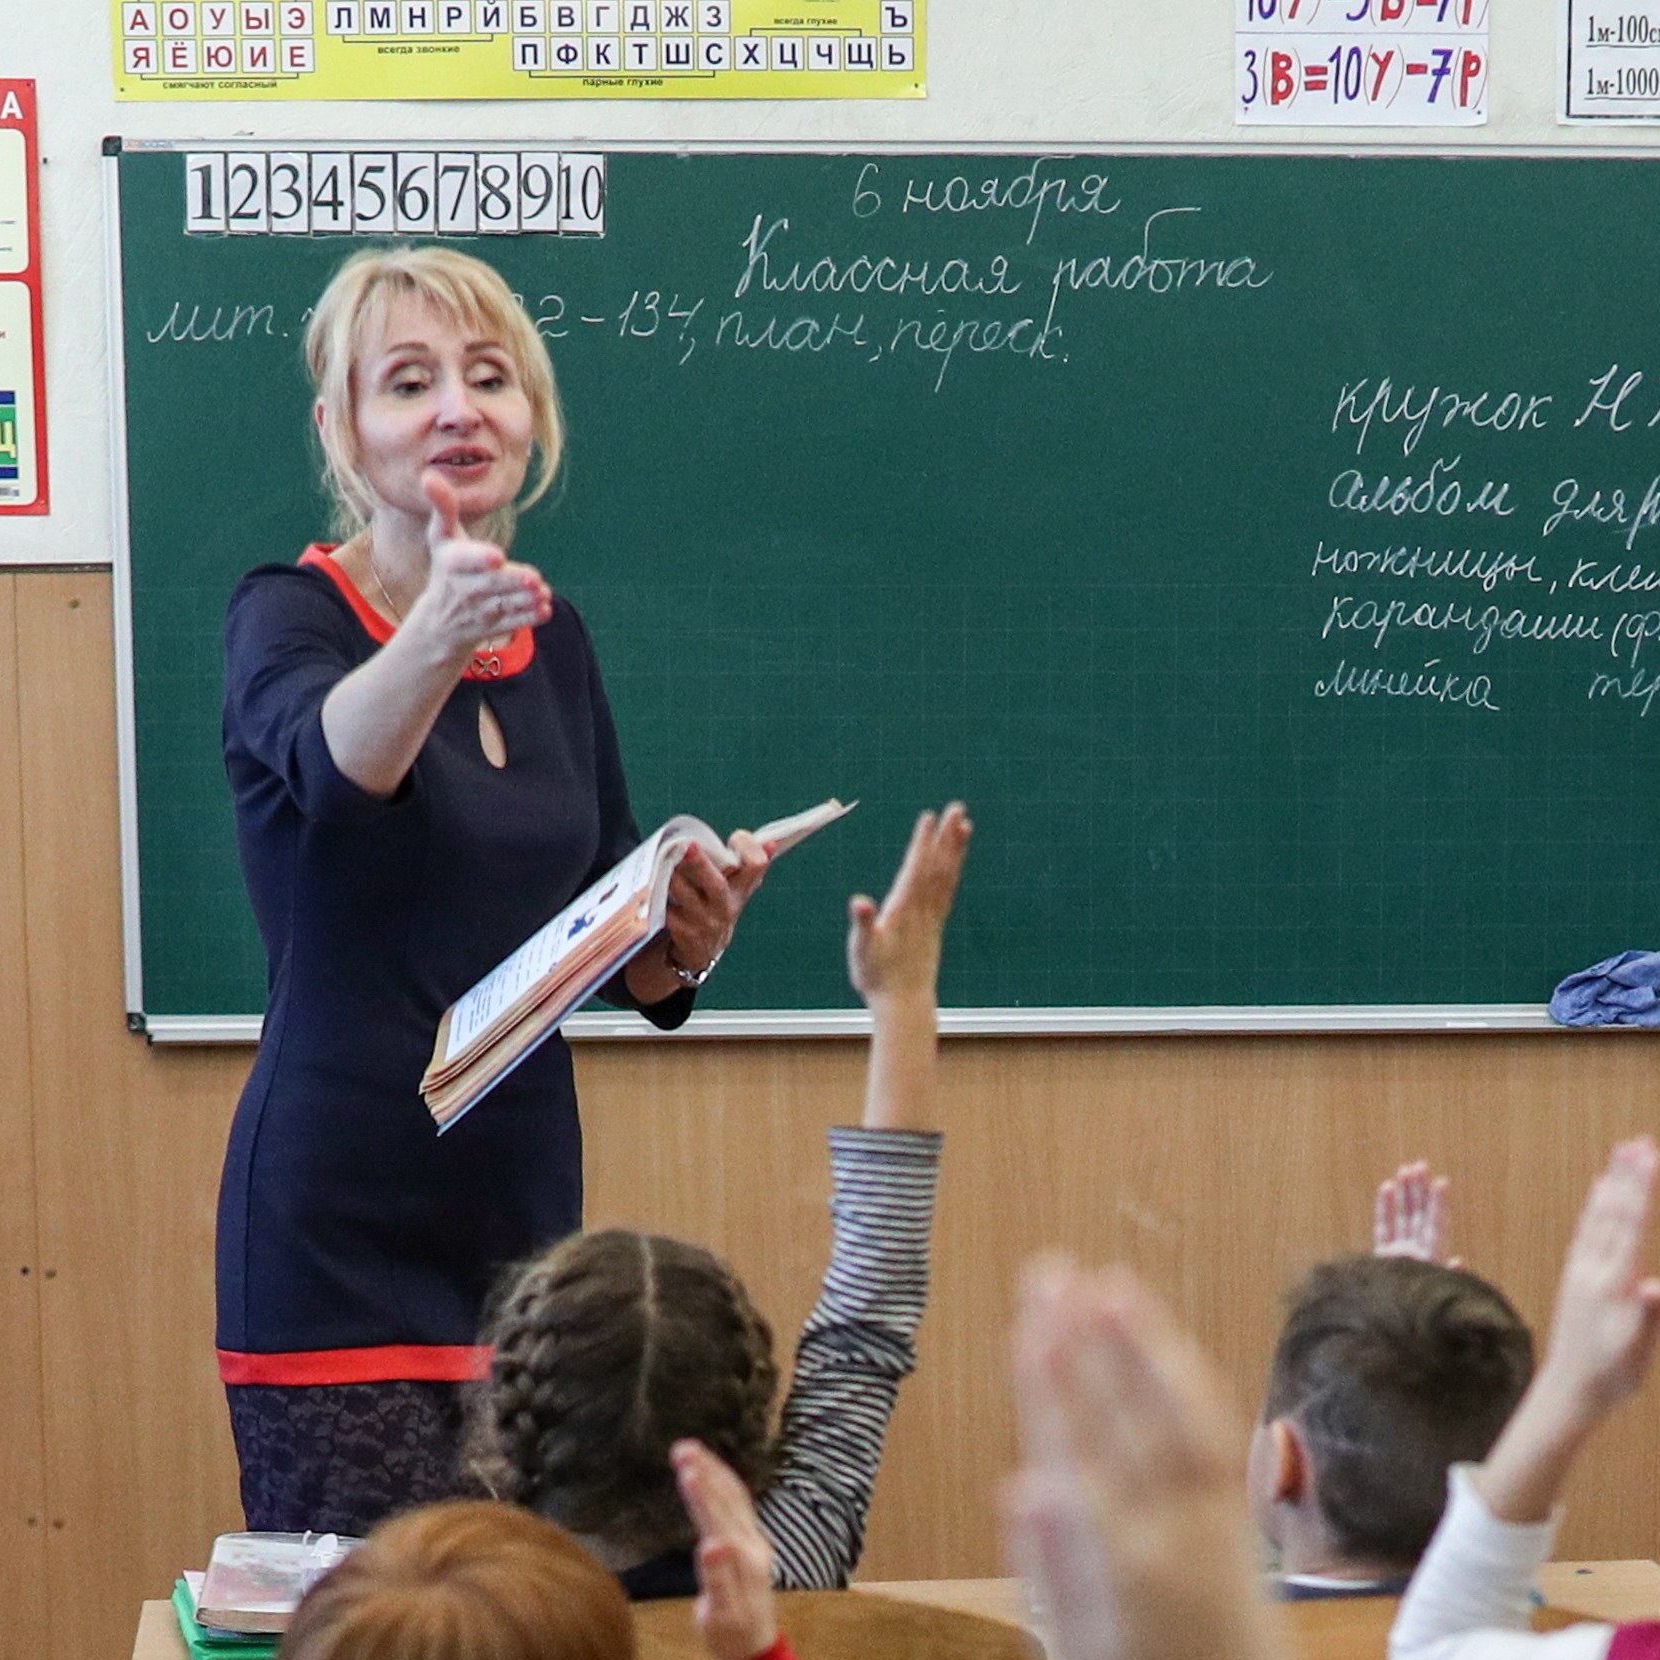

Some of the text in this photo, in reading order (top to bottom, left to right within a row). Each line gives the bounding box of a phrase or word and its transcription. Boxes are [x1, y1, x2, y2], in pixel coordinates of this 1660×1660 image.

[129, 7, 306, 31] А О У Ы Э
[133, 41, 306, 69] Я Ё Ю И Е
[378, 45, 460, 55] всегда звонкие
[218, 81, 277, 89] согласный
[583, 77, 664, 89] парные глухие
[852, 155, 1121, 244] 6 ноября
[735, 207, 1274, 339] Классная работа
